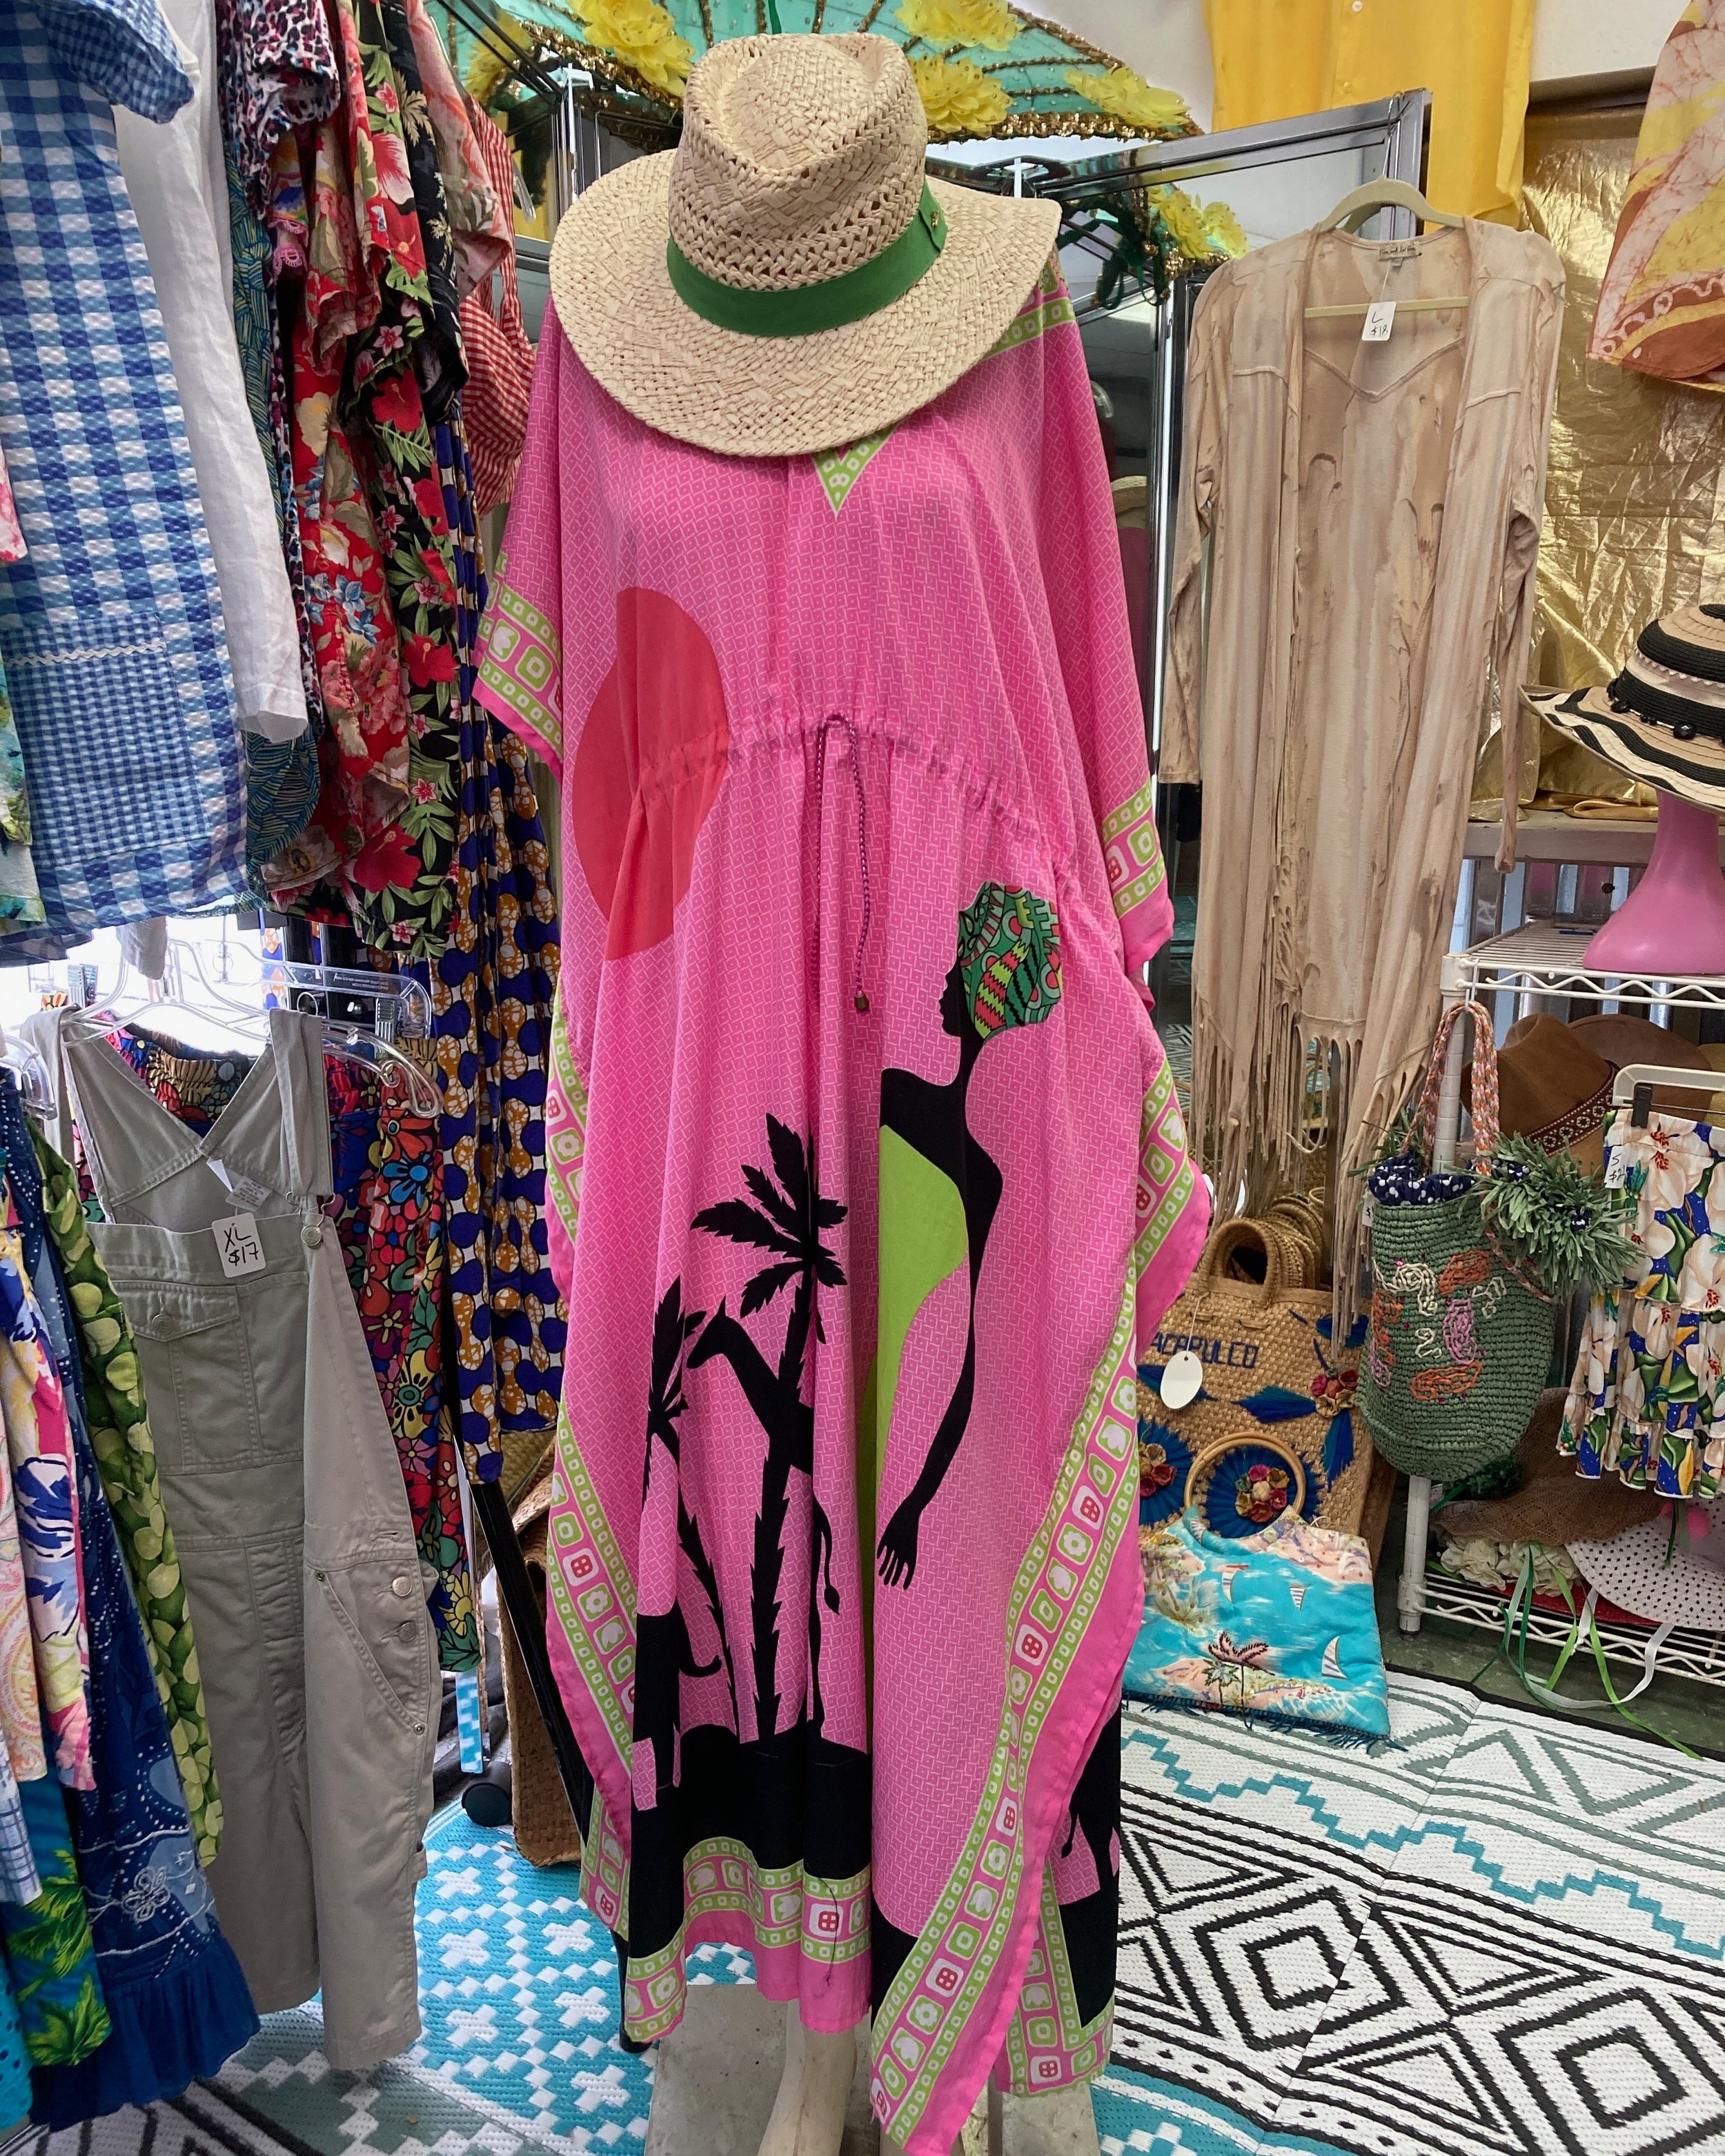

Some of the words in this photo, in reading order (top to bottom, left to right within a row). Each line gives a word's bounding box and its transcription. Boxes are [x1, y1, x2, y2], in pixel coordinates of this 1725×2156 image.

[1372, 311, 1383, 323] L
[224, 1227, 252, 1253] XL
[228, 1242, 259, 1266] $17
